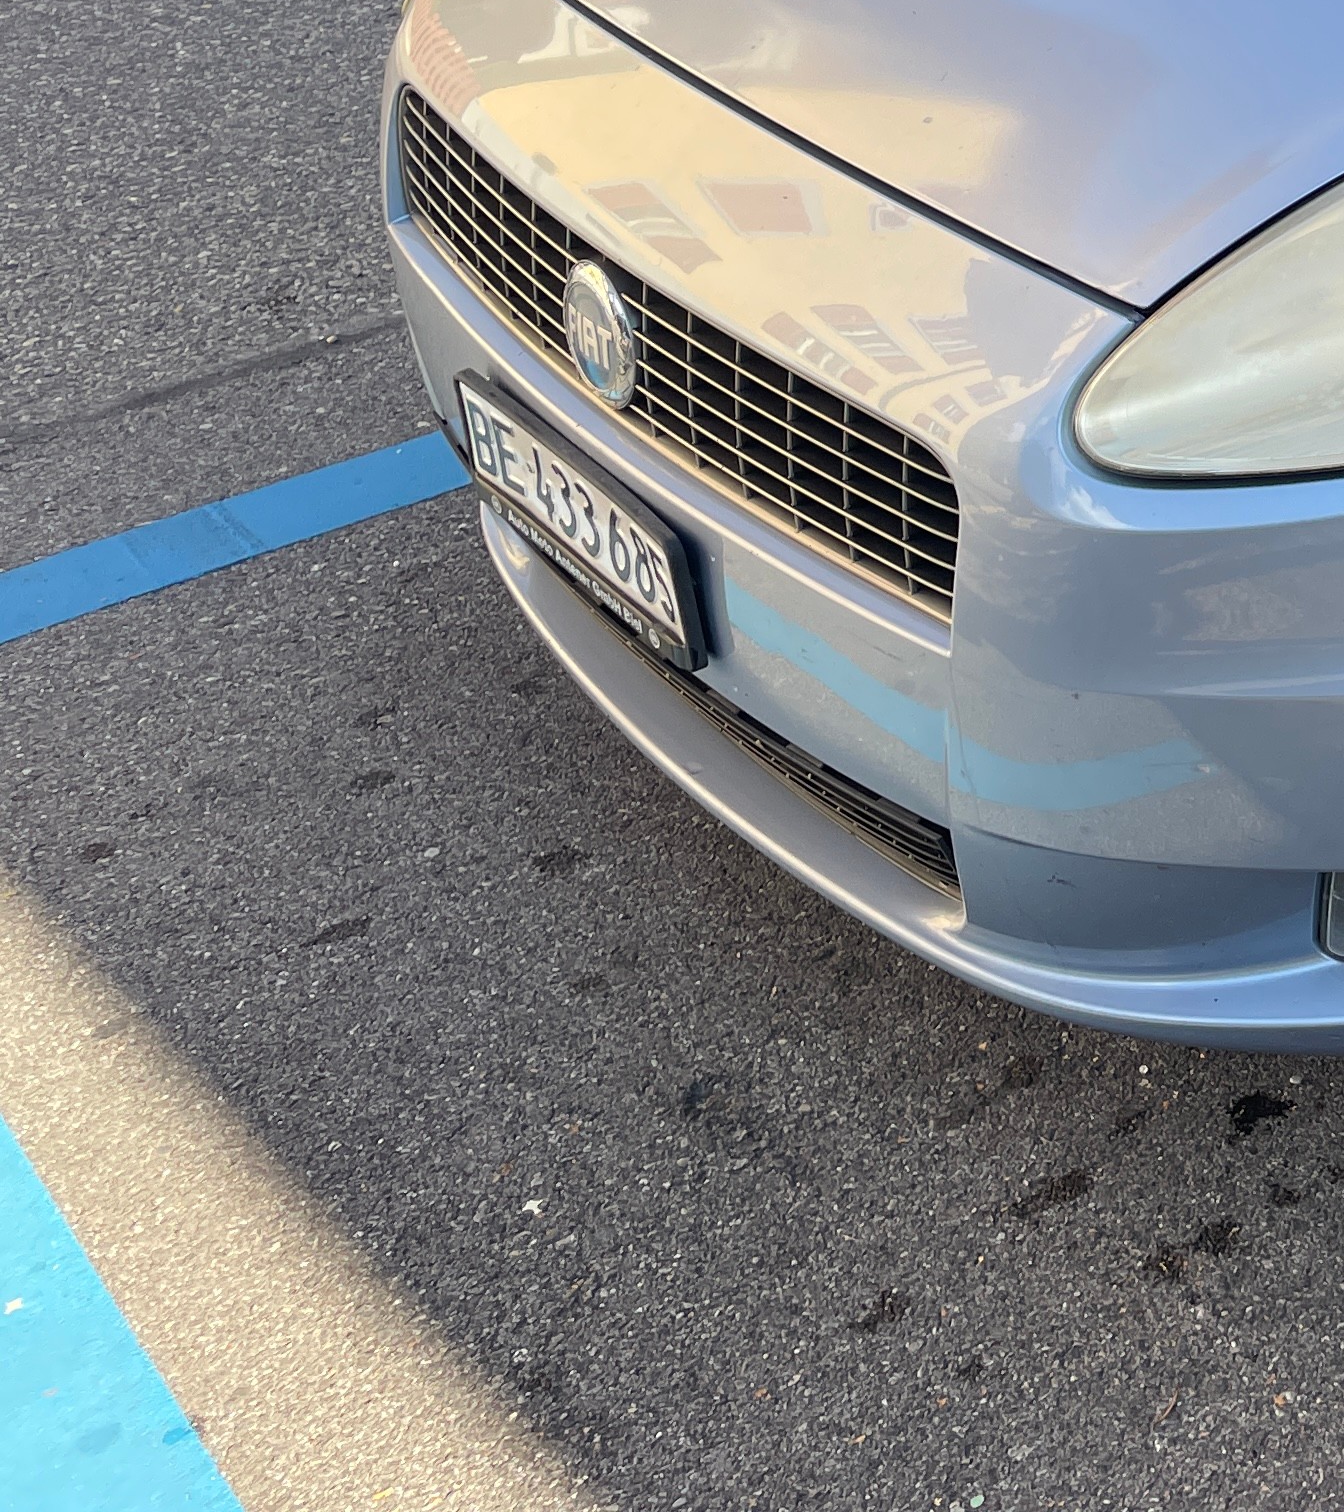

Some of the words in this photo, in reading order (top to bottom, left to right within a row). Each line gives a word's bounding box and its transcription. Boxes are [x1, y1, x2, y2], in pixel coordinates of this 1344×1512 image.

[568, 302, 612, 370] FIAT
[508, 509, 530, 537] Auto
[530, 527, 554, 557] Moto
[592, 581, 623, 617] GmbH
